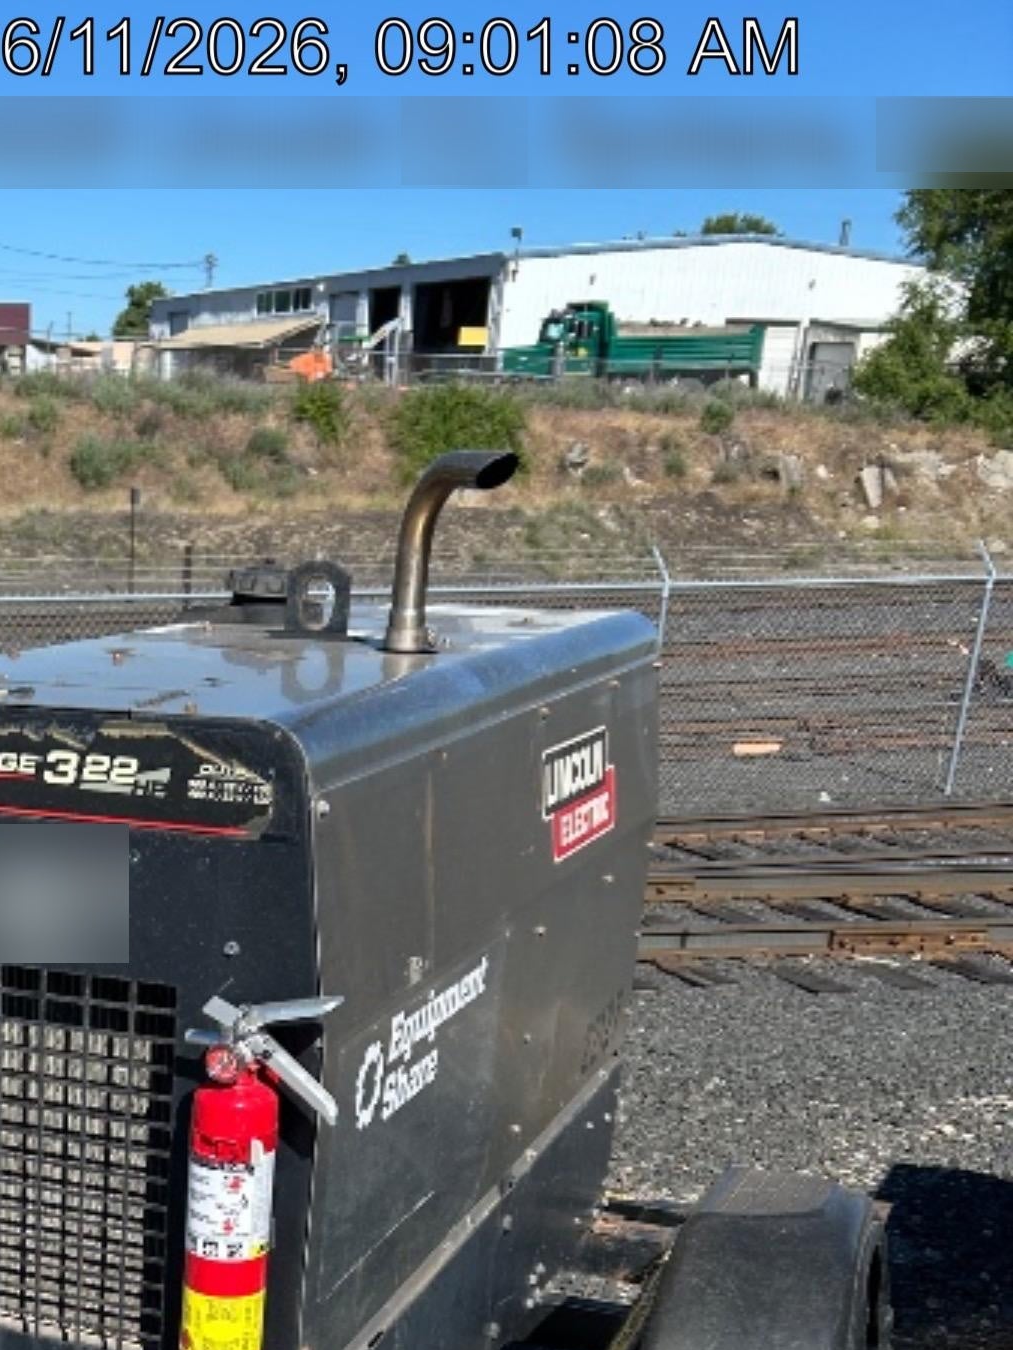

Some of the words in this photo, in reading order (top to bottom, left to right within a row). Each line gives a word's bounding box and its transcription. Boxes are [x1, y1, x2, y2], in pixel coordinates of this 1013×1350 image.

[44, 750, 138, 785] 322
[545, 740, 604, 808] LINCOLN
[560, 791, 609, 847] ELECTRIC
[389, 956, 488, 1063] Equipment
[382, 1048, 438, 1122] Share
